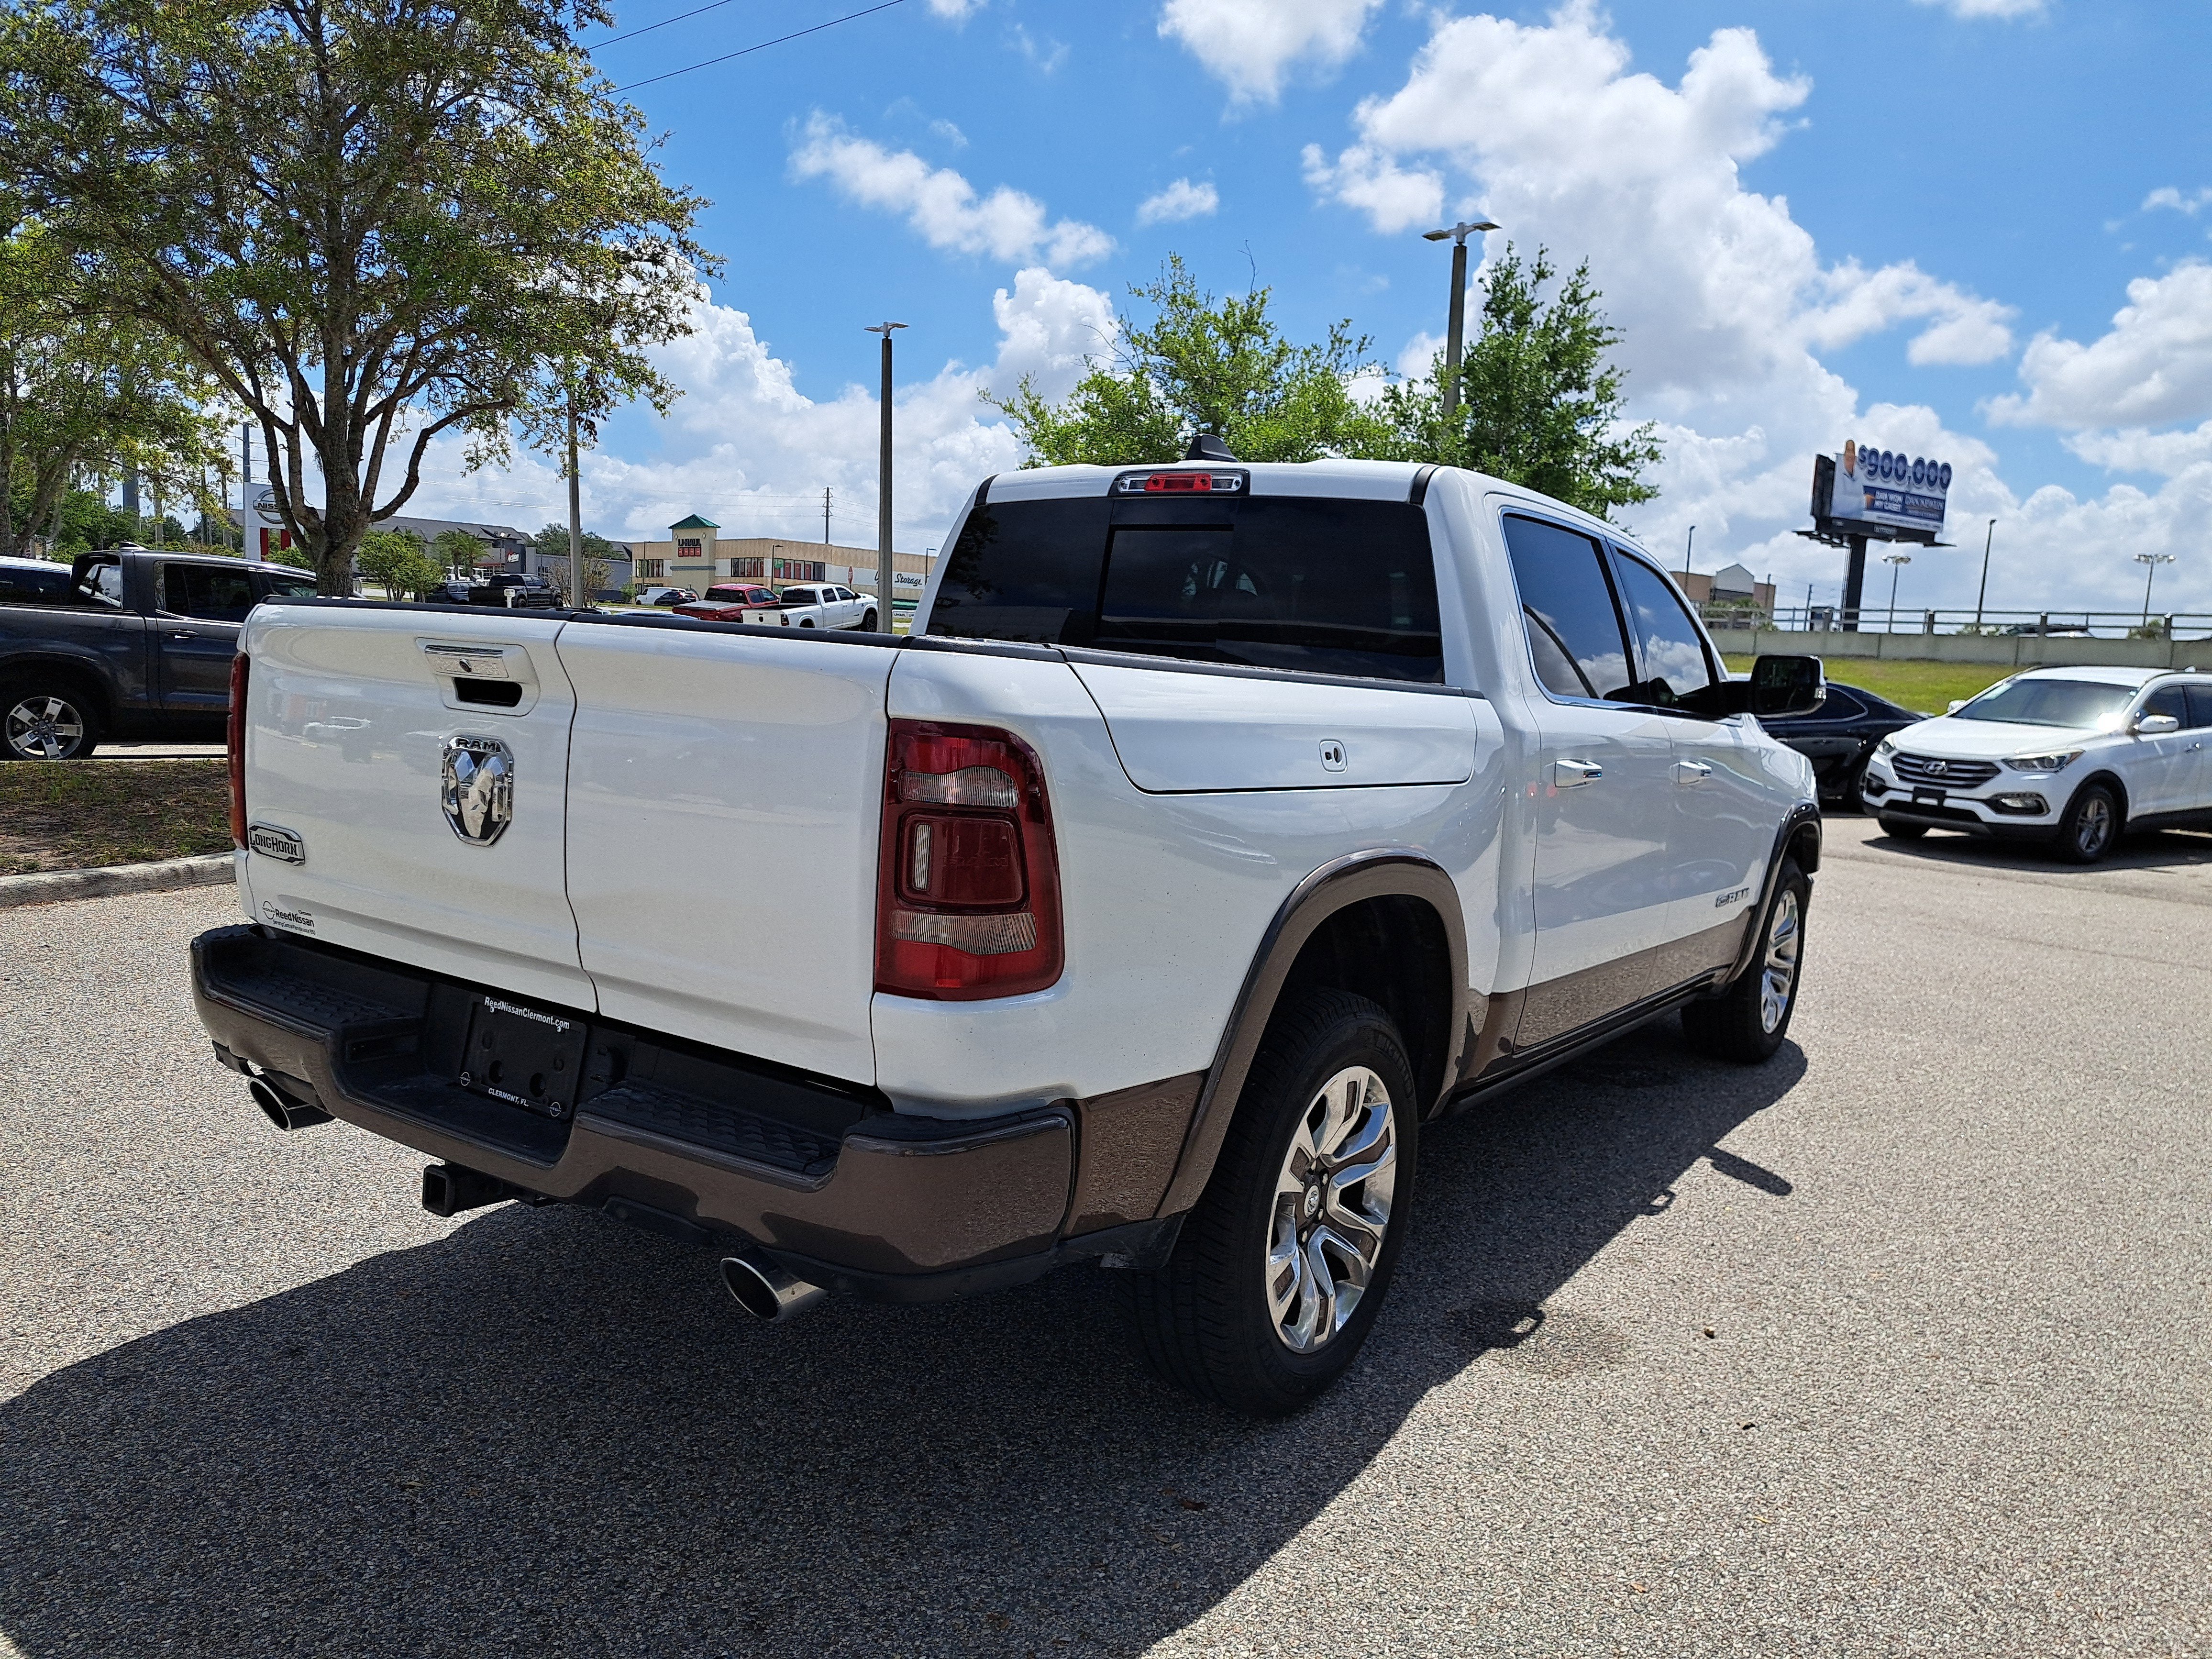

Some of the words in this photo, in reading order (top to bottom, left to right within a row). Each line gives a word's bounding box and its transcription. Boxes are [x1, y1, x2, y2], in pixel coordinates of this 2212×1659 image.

[1858, 445, 1952, 489] $900,000
[895, 574, 922, 586] Storage
[456, 738, 501, 752] RAM
[485, 996, 570, 1029] ReedNissanClermont.com
[488, 1088, 520, 1104] CLERMONT,
